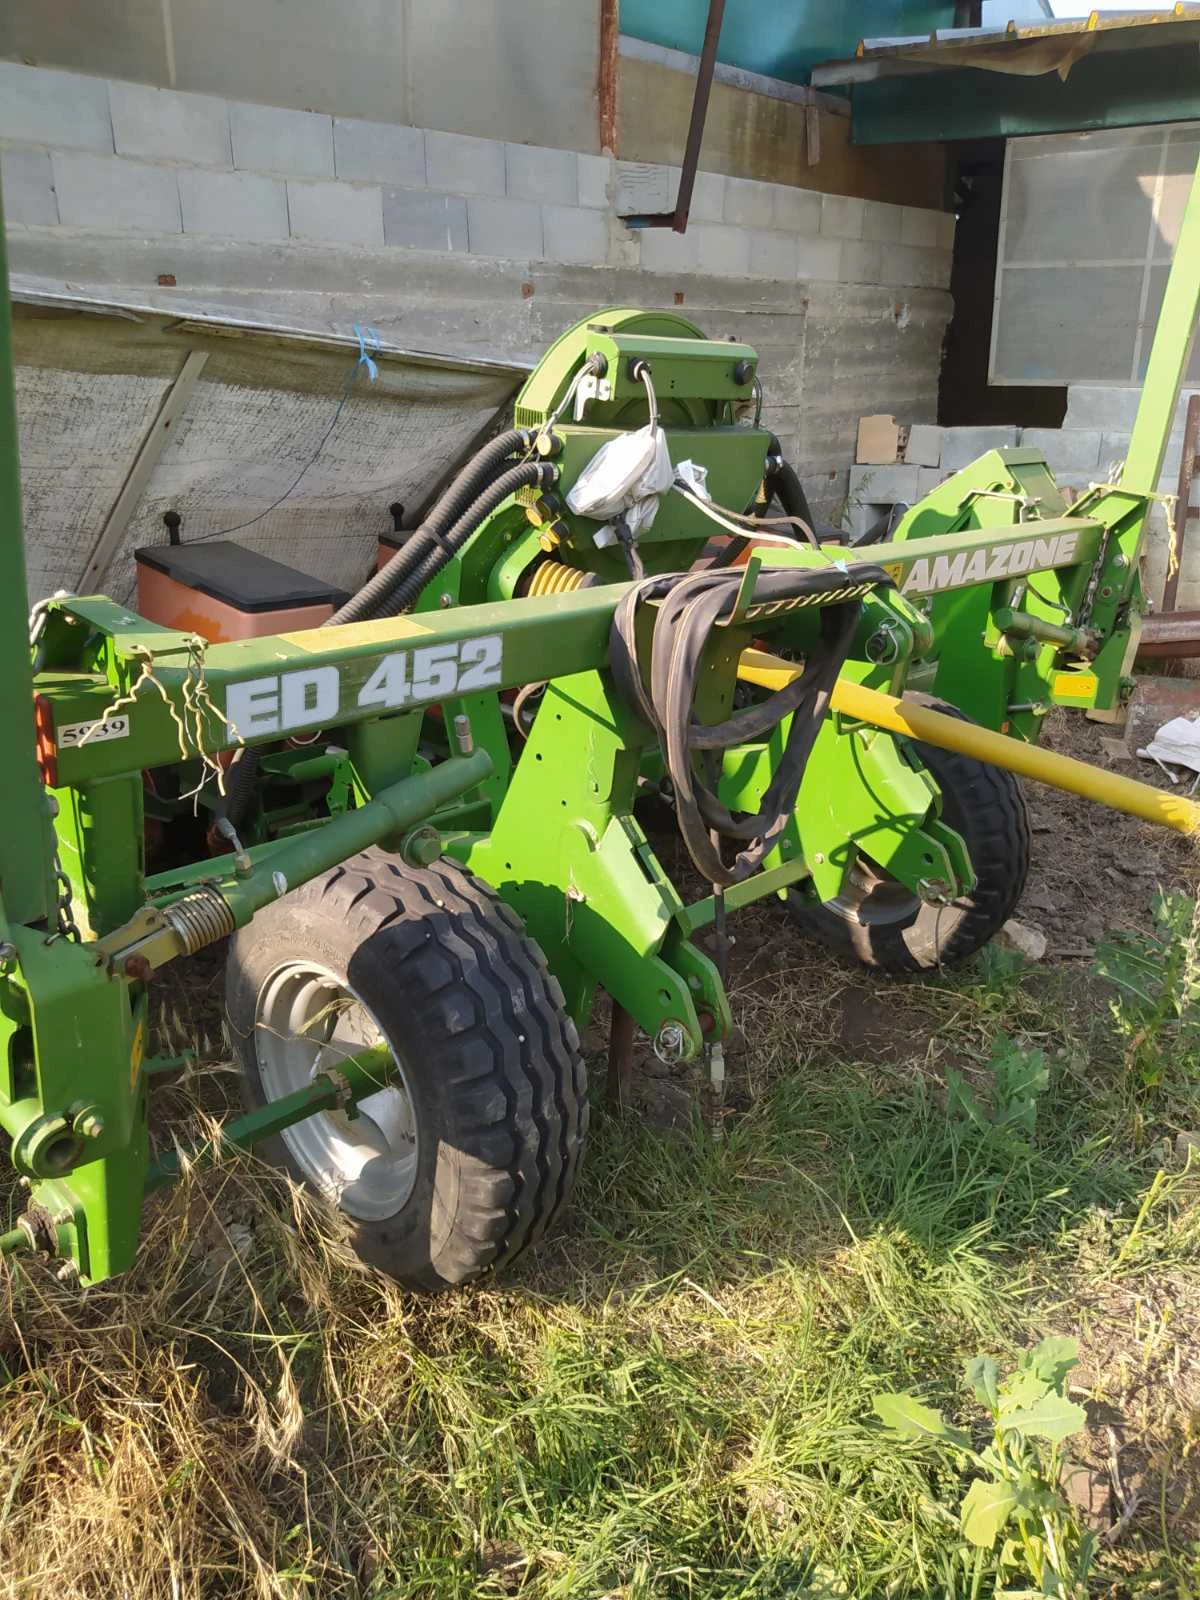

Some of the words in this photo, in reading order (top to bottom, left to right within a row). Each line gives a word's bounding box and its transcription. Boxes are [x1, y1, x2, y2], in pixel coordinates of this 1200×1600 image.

[900, 532, 1079, 596] AMAZONE
[226, 666, 339, 744] ED
[358, 634, 503, 706] 452
